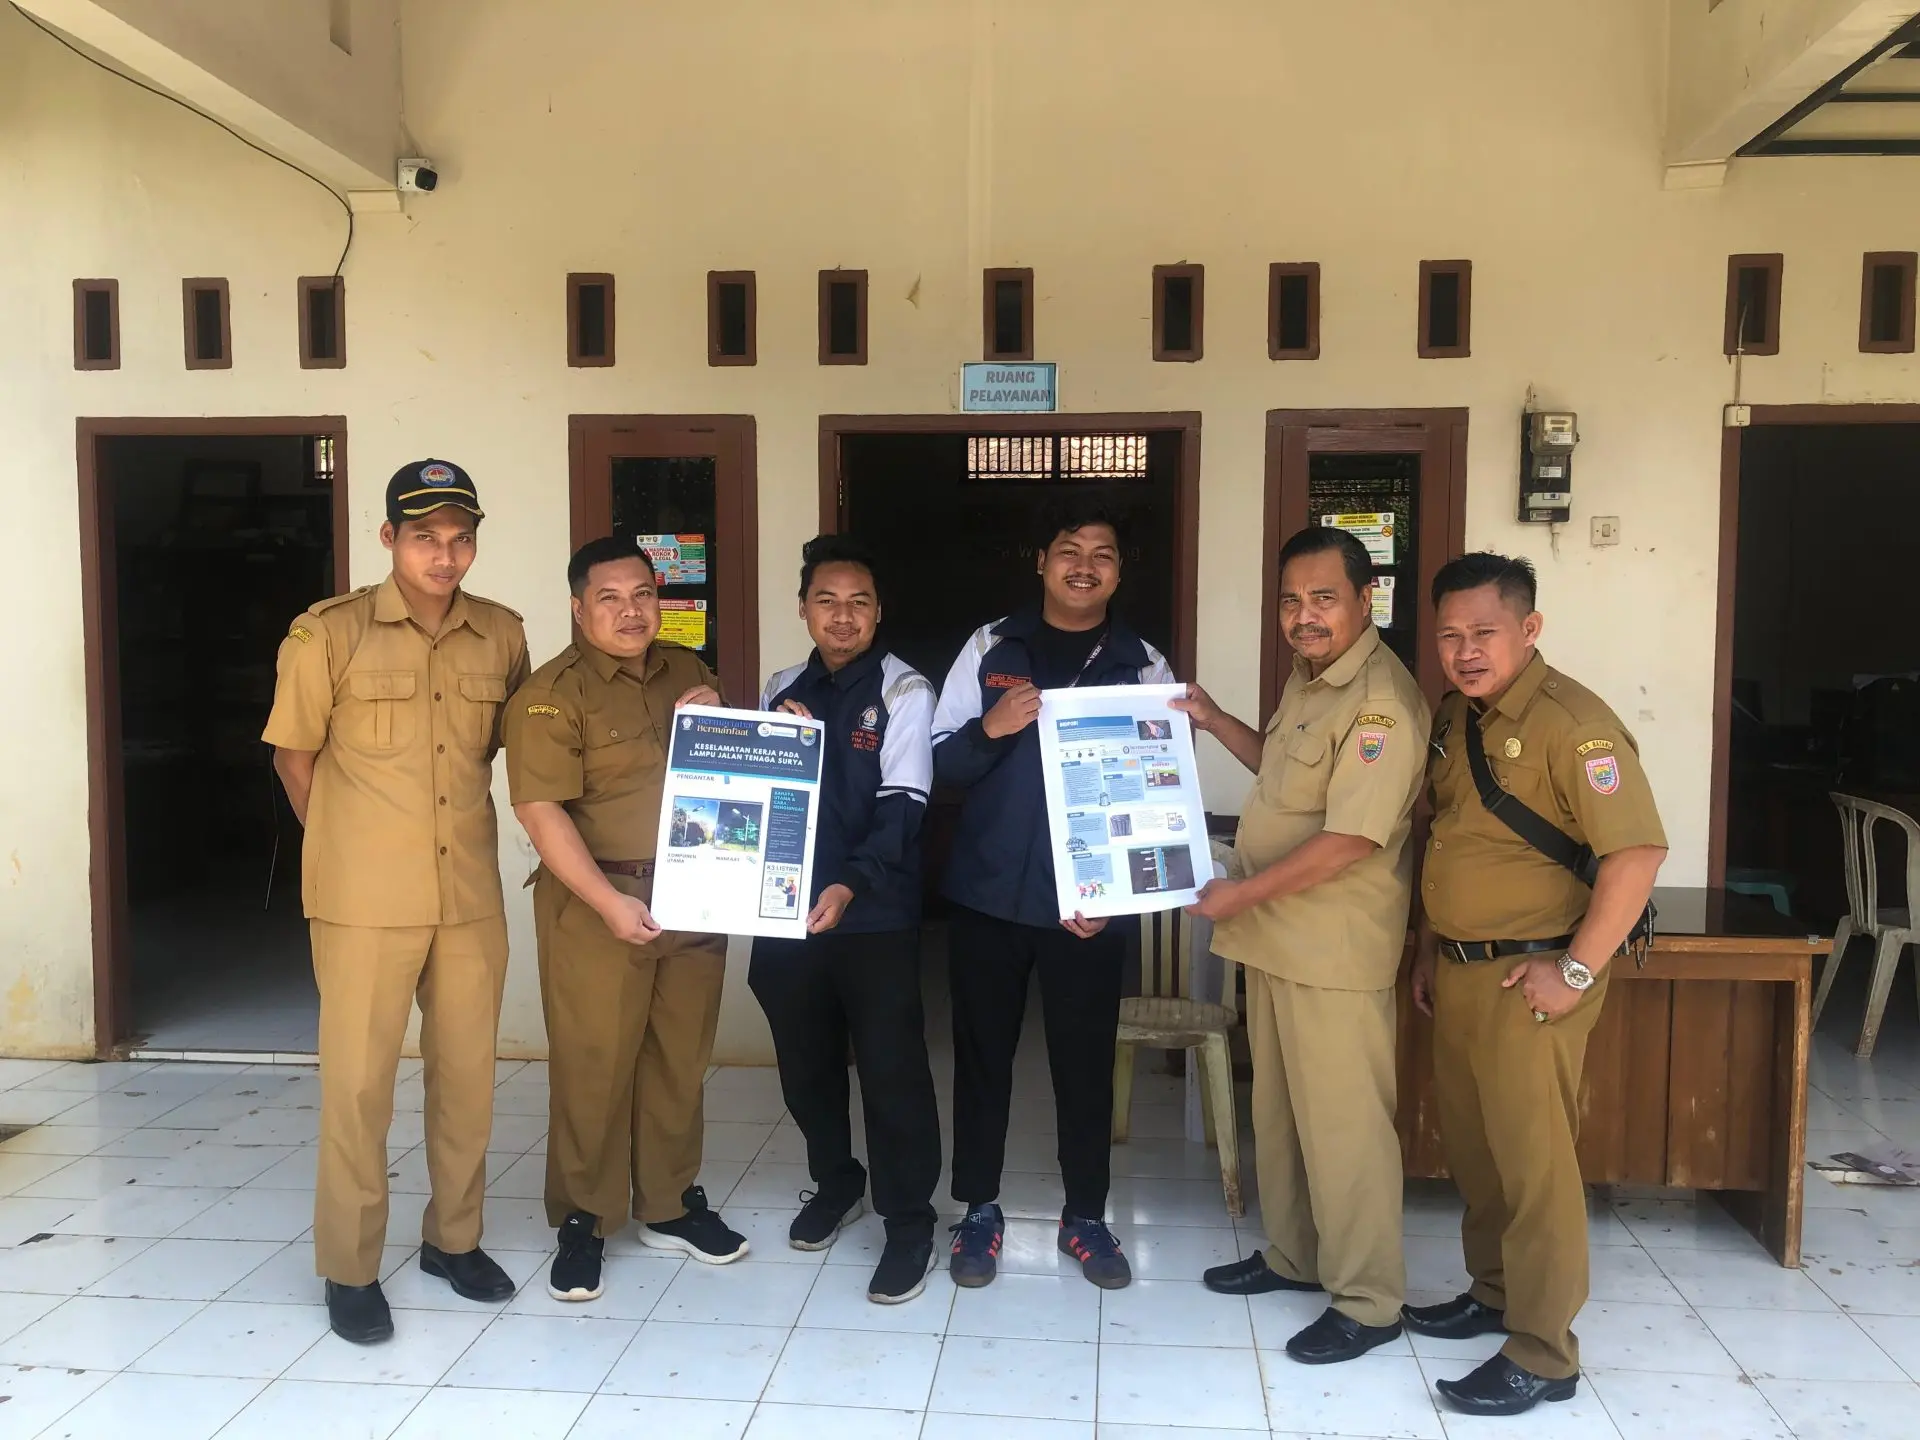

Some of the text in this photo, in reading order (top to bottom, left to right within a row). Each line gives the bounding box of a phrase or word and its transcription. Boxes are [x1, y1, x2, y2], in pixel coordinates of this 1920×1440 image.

[986, 371, 1035, 383] RUANG
[970, 390, 1050, 402] PELAYANAN
[694, 743, 750, 754] KESELAMATAN
[753, 747, 777, 756] KERJA
[717, 752, 742, 760] JALAN
[745, 754, 776, 764] TENAGA
[676, 773, 715, 782] PENGANTAR
